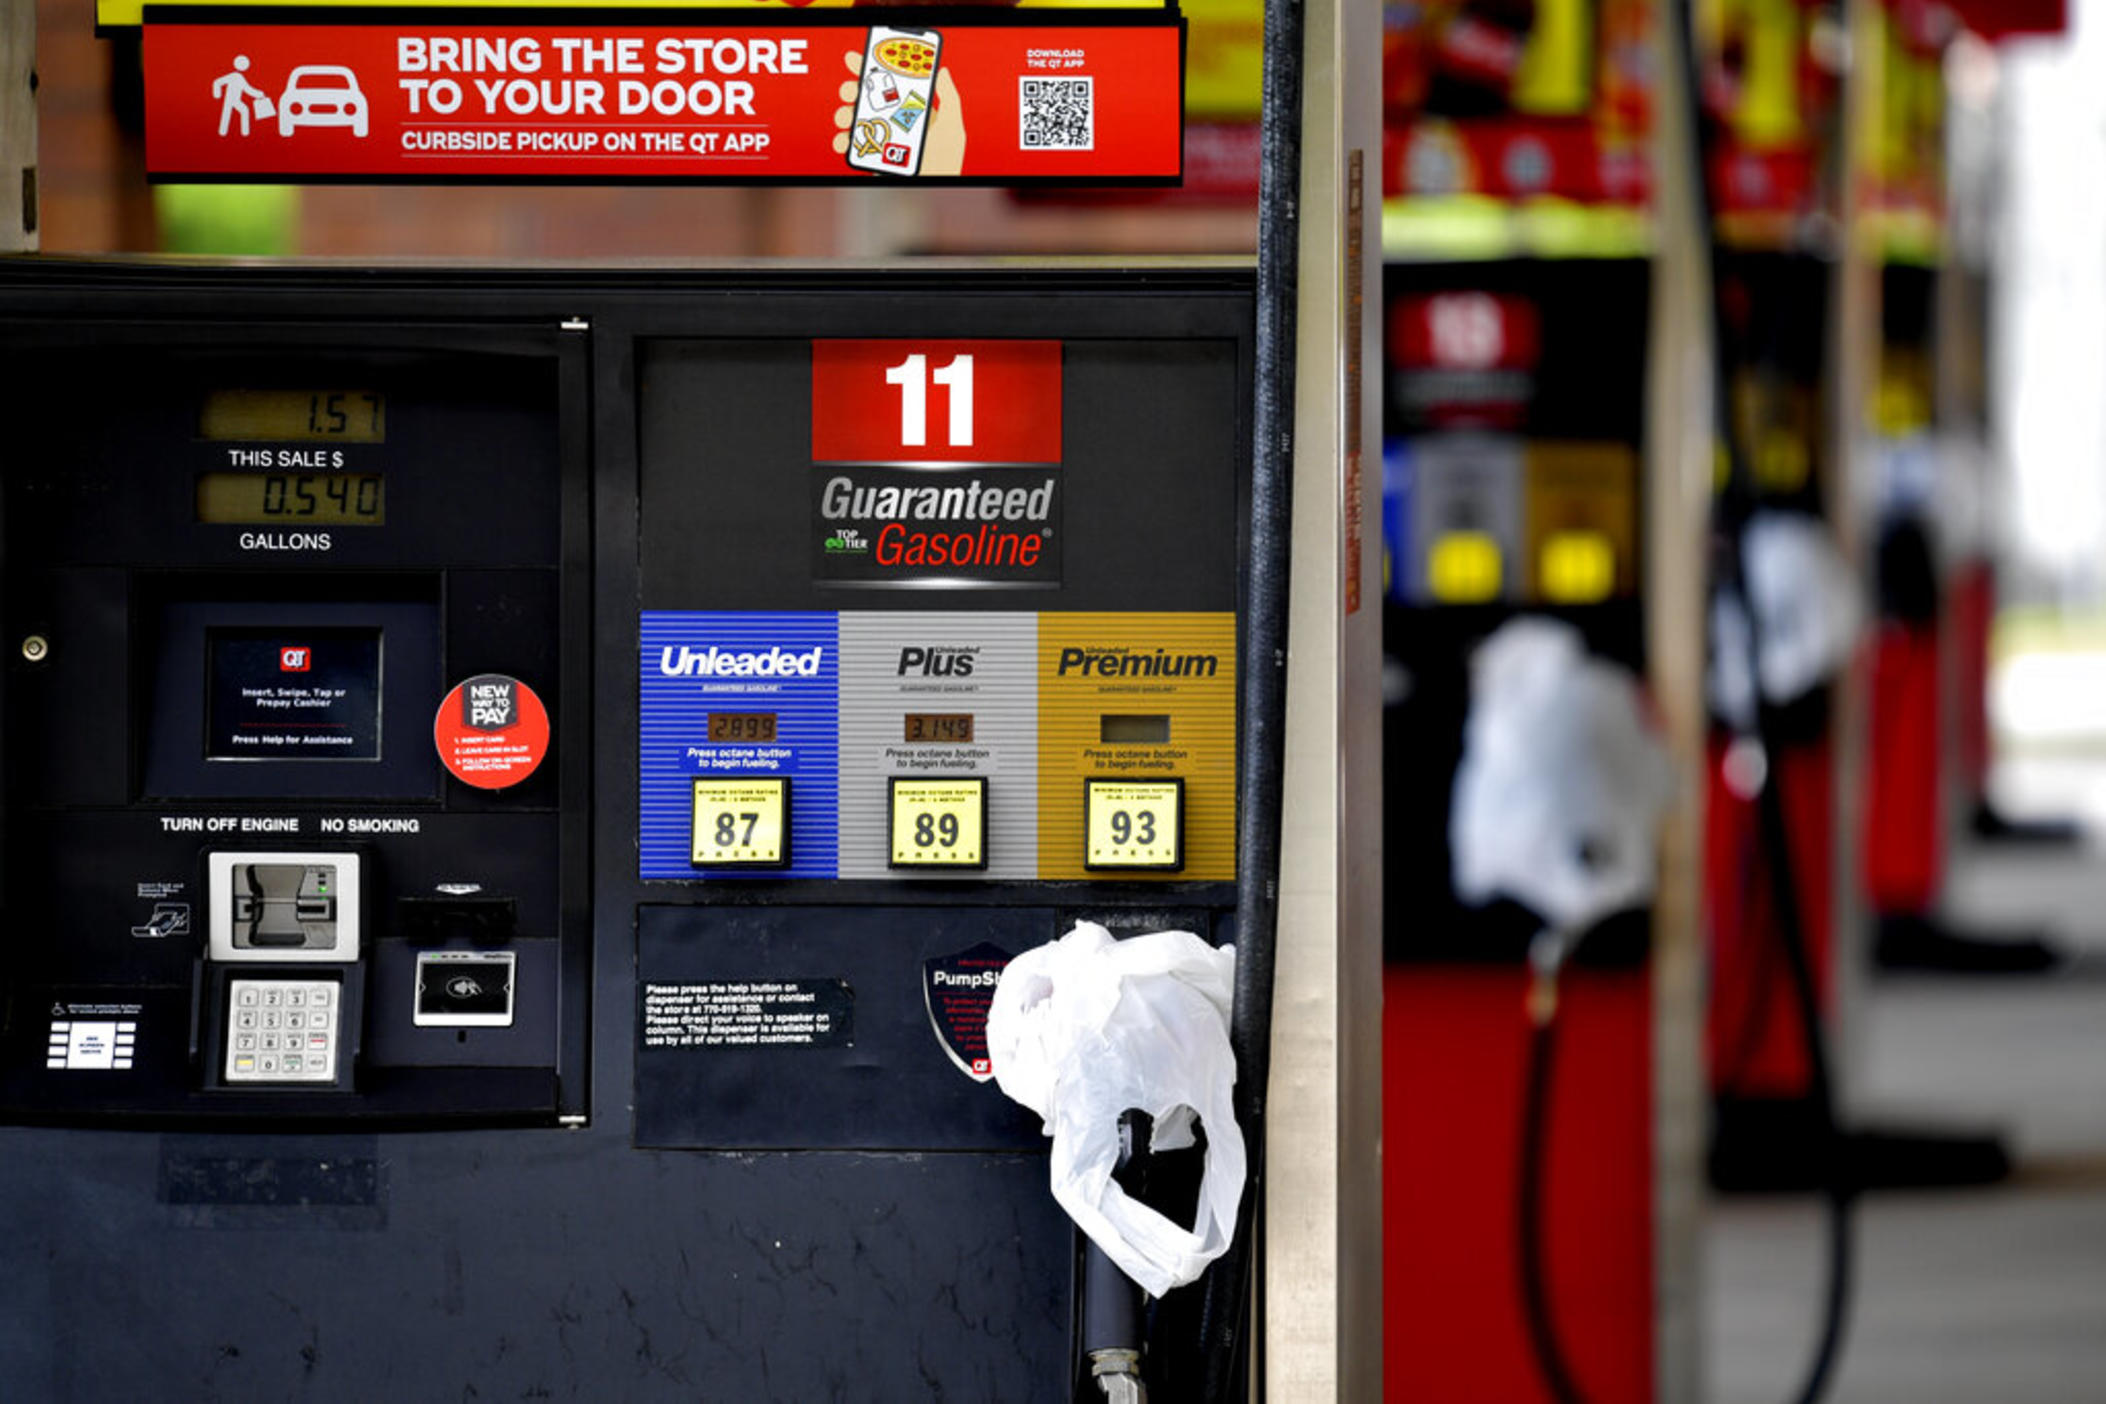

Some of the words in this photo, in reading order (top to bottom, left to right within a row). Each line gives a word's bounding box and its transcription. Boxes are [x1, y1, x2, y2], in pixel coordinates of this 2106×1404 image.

[398, 37, 541, 72] BRING
[552, 38, 644, 74] THE
[655, 38, 809, 74] STORE
[1027, 49, 1085, 59] DOWNLOAD
[1027, 60, 1046, 69] THE
[1049, 60, 1062, 69] QT
[1064, 59, 1085, 69] APP
[399, 79, 463, 114] TO
[474, 79, 606, 115] YOUR
[618, 80, 756, 116] DOOR
[401, 131, 512, 151] CURBSIDE
[516, 132, 599, 152] PICKUP
[603, 132, 637, 151] ON
[640, 132, 685, 152] THE
[689, 132, 719, 154] QT
[723, 132, 770, 152] APP
[885, 147, 907, 164] QT
[886, 353, 974, 446] 11
[309, 394, 379, 433] 1.57
[228, 450, 273, 467] THIS
[278, 451, 327, 467] SALE
[332, 451, 345, 468] $
[263, 476, 380, 515] 0.540
[821, 476, 1056, 521] Guaranteed
[836, 529, 859, 539] TOP
[239, 532, 332, 551] GALLONS
[845, 538, 869, 549] TIER
[283, 650, 306, 668] QT
[660, 646, 823, 676] Unleaded
[897, 647, 975, 677] Plus
[1057, 648, 1219, 677] Premium
[313, 688, 332, 699] Tap
[334, 689, 346, 698] or
[470, 685, 510, 698] NEW
[256, 699, 291, 709] Prepay
[293, 698, 331, 708] Cashier
[472, 699, 494, 708] WAY
[496, 698, 511, 707] TO
[471, 707, 511, 725] PAY
[232, 735, 259, 744] Press
[262, 735, 284, 745] Help
[285, 735, 300, 745] for
[302, 735, 353, 745] Assistance
[687, 748, 717, 758] Press
[719, 748, 755, 758] octane
[757, 748, 793, 758] button
[885, 748, 915, 758] Press
[917, 749, 953, 758] octane
[955, 749, 990, 758] button
[1084, 749, 1113, 758] Press
[1115, 749, 1152, 759] octane
[1153, 749, 1188, 759] button
[699, 759, 710, 768] to
[711, 759, 741, 770] begin
[896, 759, 908, 768] to
[909, 759, 938, 770] begin
[1095, 760, 1106, 768] to
[1108, 760, 1136, 770] begin
[161, 818, 203, 833] TURN
[206, 818, 238, 833] OFF
[242, 818, 299, 833] ENGINE
[321, 818, 345, 833] NO
[347, 818, 420, 834] SMOKING
[715, 812, 760, 847] 87
[914, 812, 959, 848] 89
[1111, 810, 1156, 845] 93
[646, 984, 679, 995] Please
[680, 985, 708, 996] press
[709, 983, 727, 994] the
[727, 983, 749, 995] help
[750, 983, 783, 993] button
[784, 984, 798, 993] on
[646, 994, 694, 1006] dispenser
[696, 993, 710, 1003] for
[711, 993, 764, 1004] assistance
[765, 994, 777, 1003] or
[778, 992, 815, 1003] contact
[646, 1004, 662, 1014] the
[663, 1004, 691, 1014] store
[692, 1004, 702, 1014] at
[646, 1014, 679, 1025] Please
[680, 1014, 710, 1025] direct
[711, 1015, 734, 1026] your
[735, 1013, 762, 1024] voice
[763, 1014, 774, 1023] to
[775, 1012, 815, 1024] speaker
[816, 1013, 830, 1023] on
[687, 1024, 708, 1035] This
[710, 1023, 758, 1035] dispenser
[760, 1023, 770, 1033] is
[771, 1022, 815, 1033] available
[816, 1022, 831, 1033] for
[646, 1036, 664, 1045] use
[665, 1035, 680, 1047] by
[680, 1035, 692, 1045] all
[694, 1035, 705, 1045] of
[706, 1035, 723, 1045] our
[725, 1034, 758, 1044] valued
